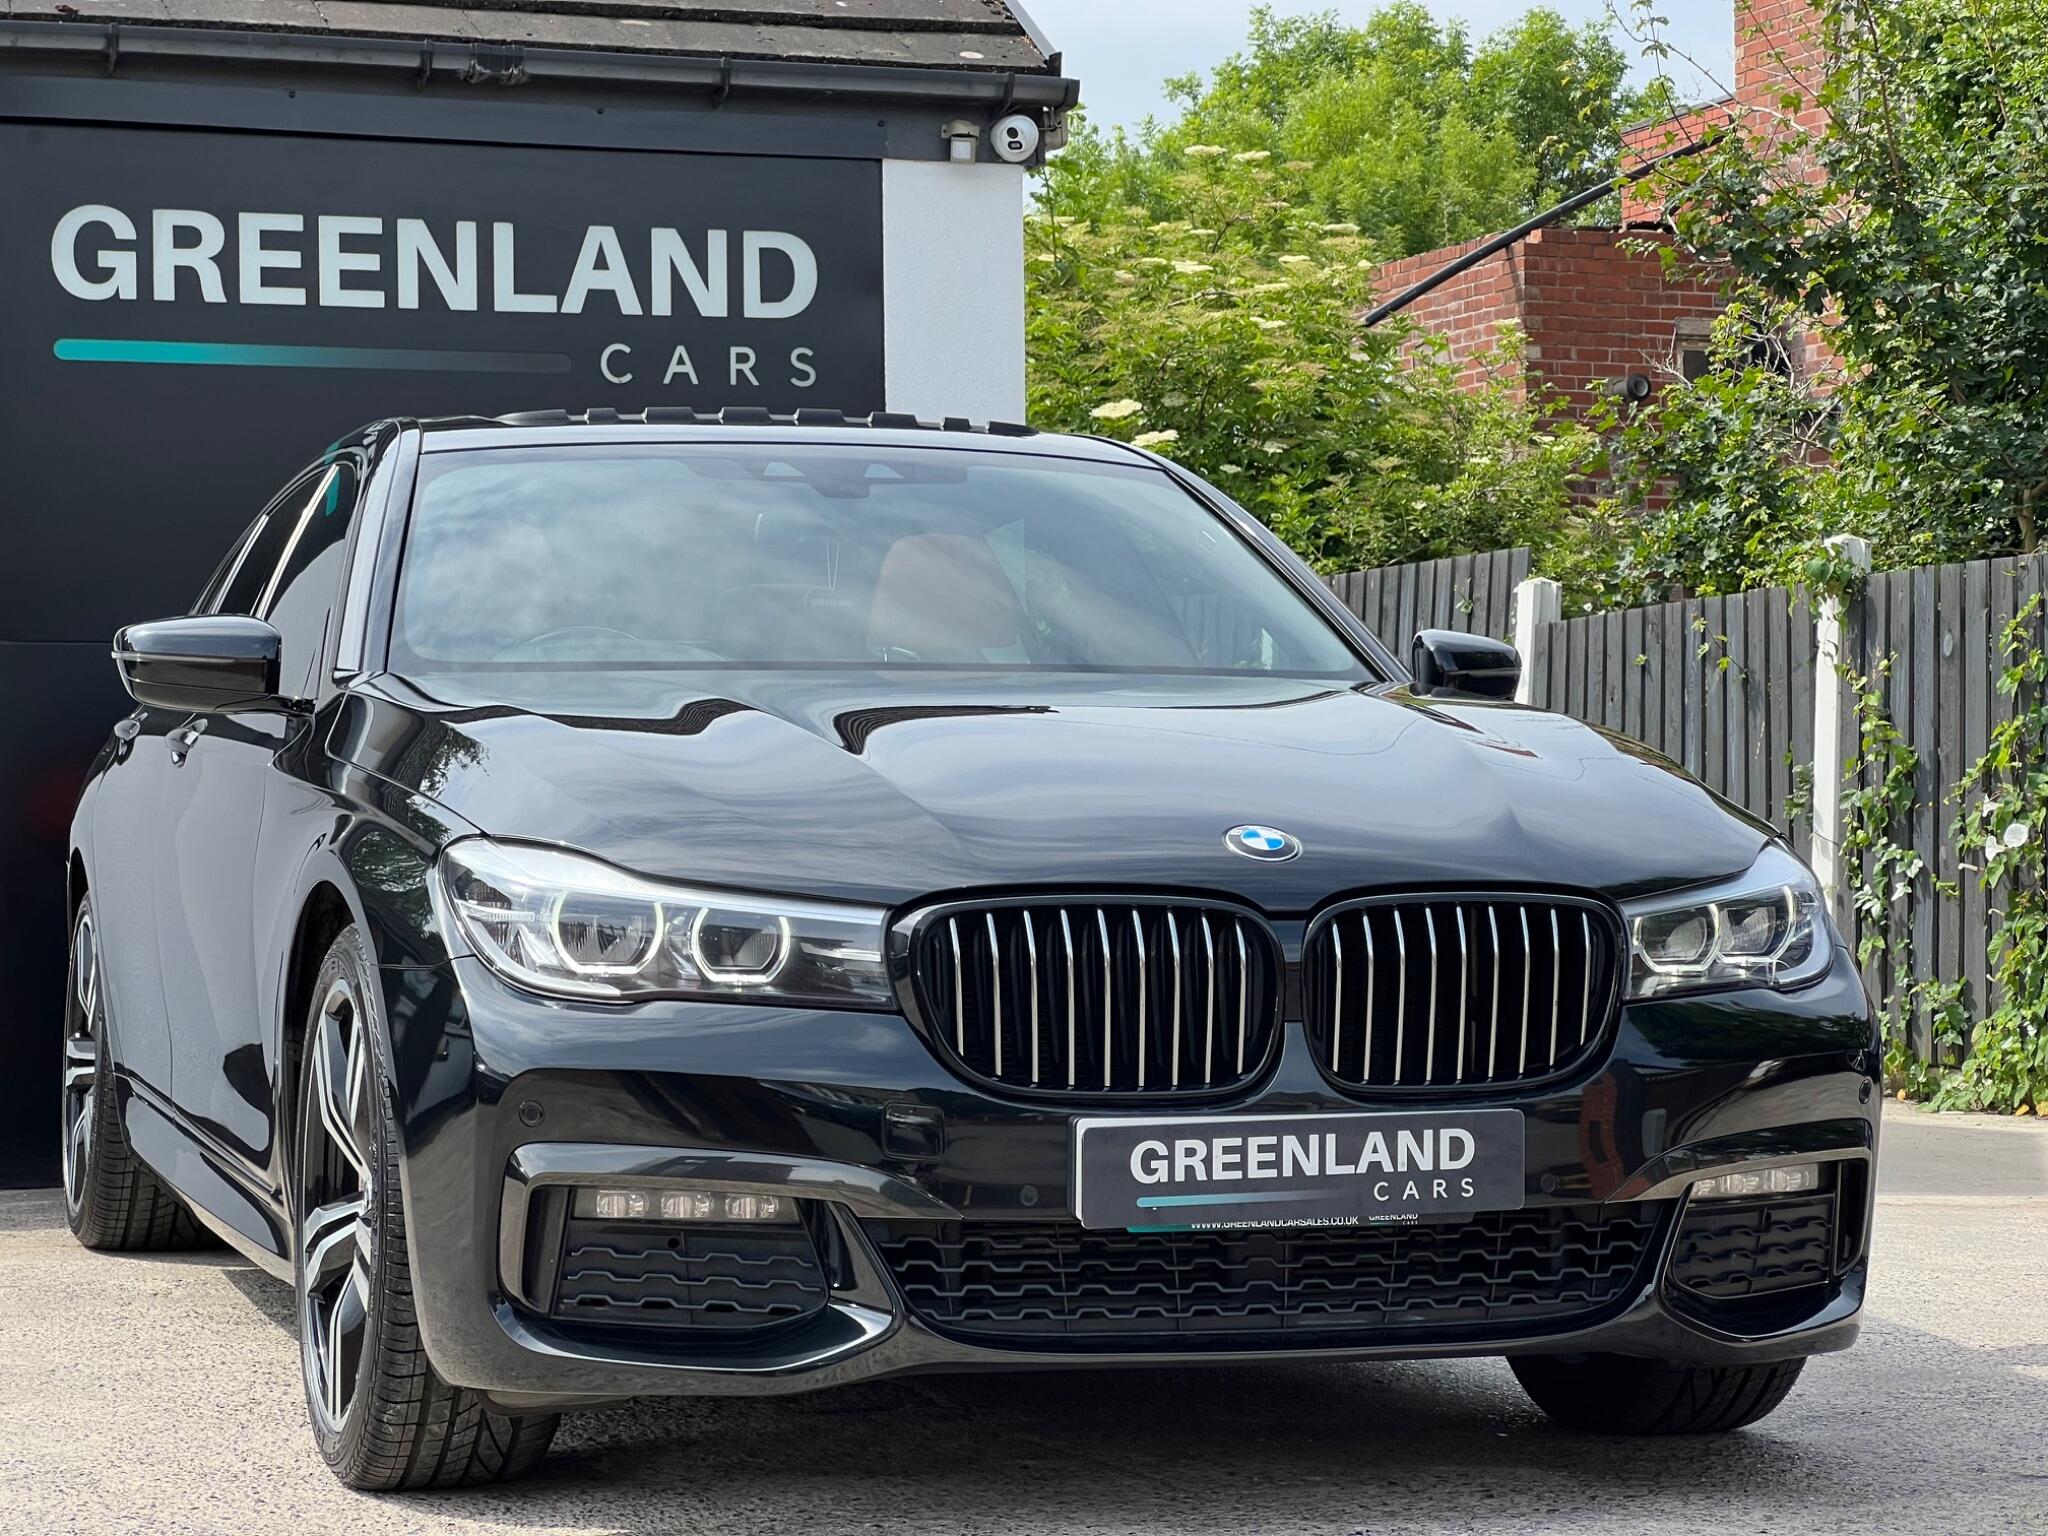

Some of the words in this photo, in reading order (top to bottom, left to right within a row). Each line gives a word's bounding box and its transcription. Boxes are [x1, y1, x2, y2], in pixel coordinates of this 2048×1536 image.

[50, 203, 819, 319] GREENLAND
[599, 342, 818, 387] CARS
[1129, 1127, 1476, 1185] GREENLAND
[1373, 1177, 1475, 1202] CARS
